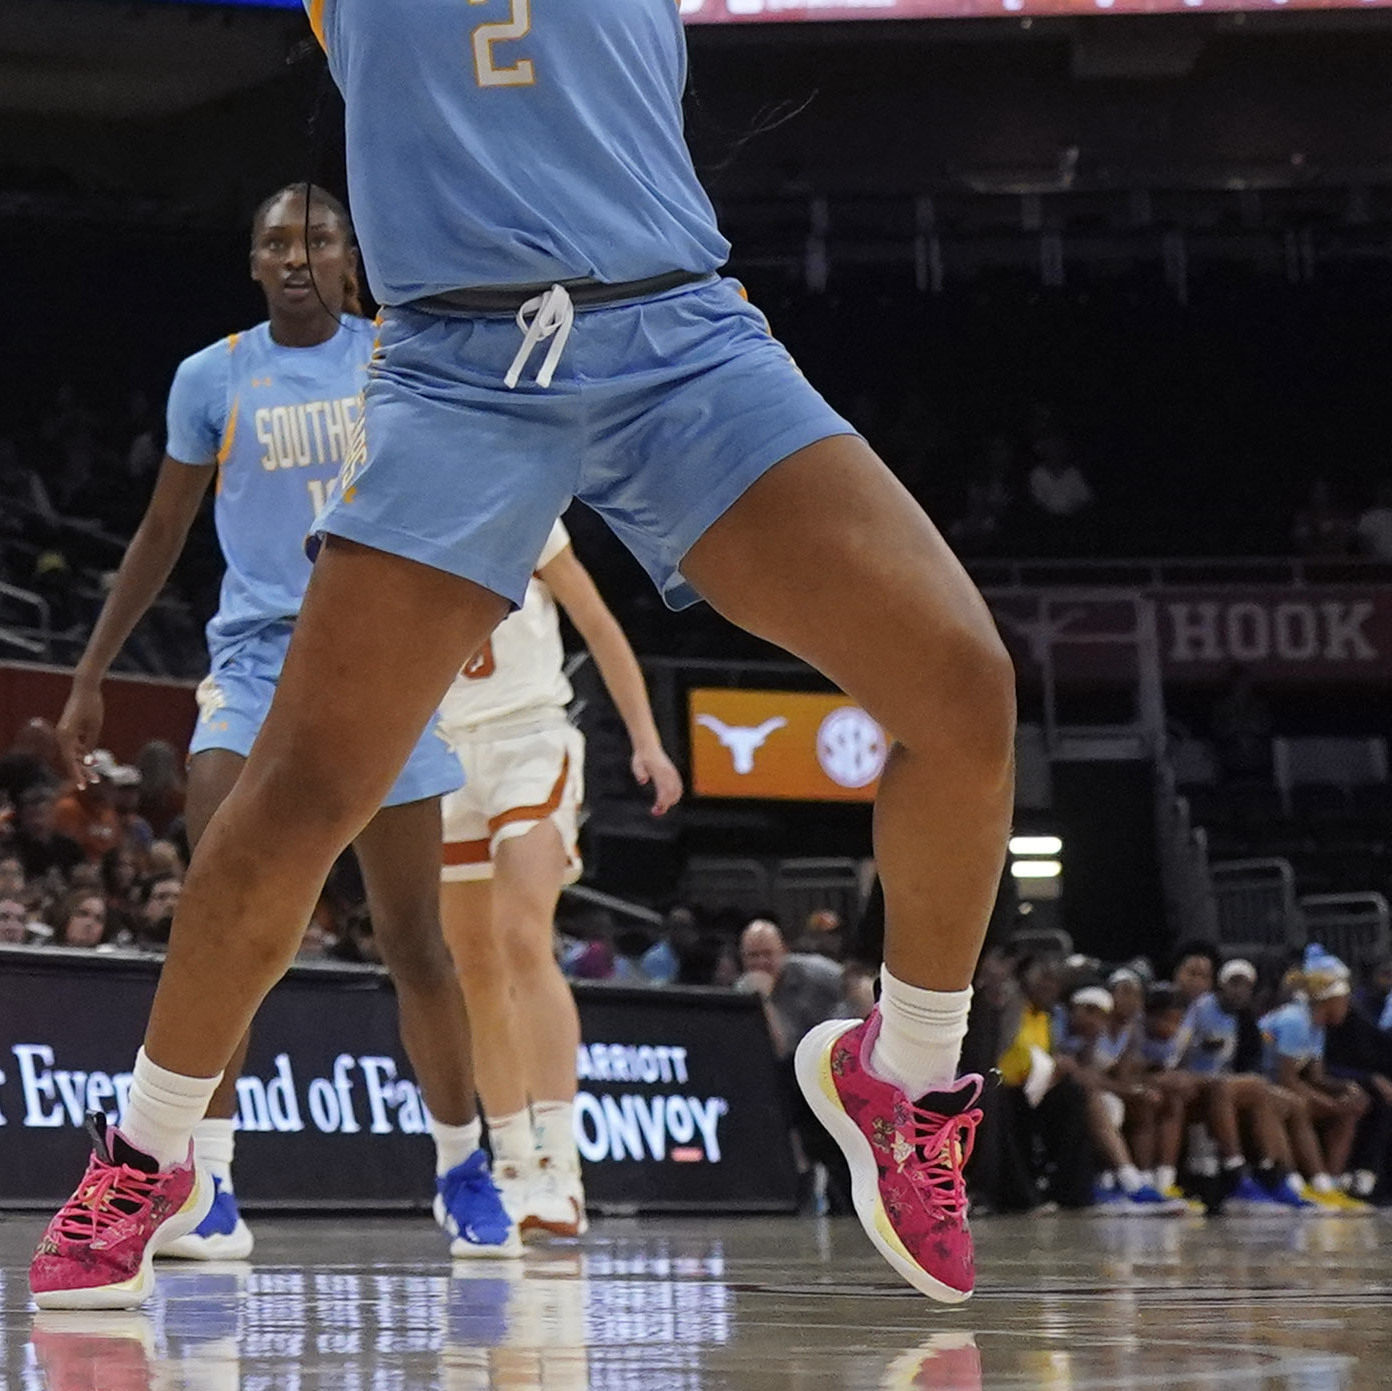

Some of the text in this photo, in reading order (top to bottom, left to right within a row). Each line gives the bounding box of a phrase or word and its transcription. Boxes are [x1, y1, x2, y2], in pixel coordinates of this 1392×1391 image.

[255, 395, 360, 471] SOUTHE
[1169, 602, 1378, 663] HOOK
[12, 1044, 134, 1128] Ever
[231, 1053, 305, 1132] nd
[308, 1053, 361, 1133] of
[576, 1042, 689, 1085] ARRIOTT
[572, 1091, 722, 1163] ONVOY
